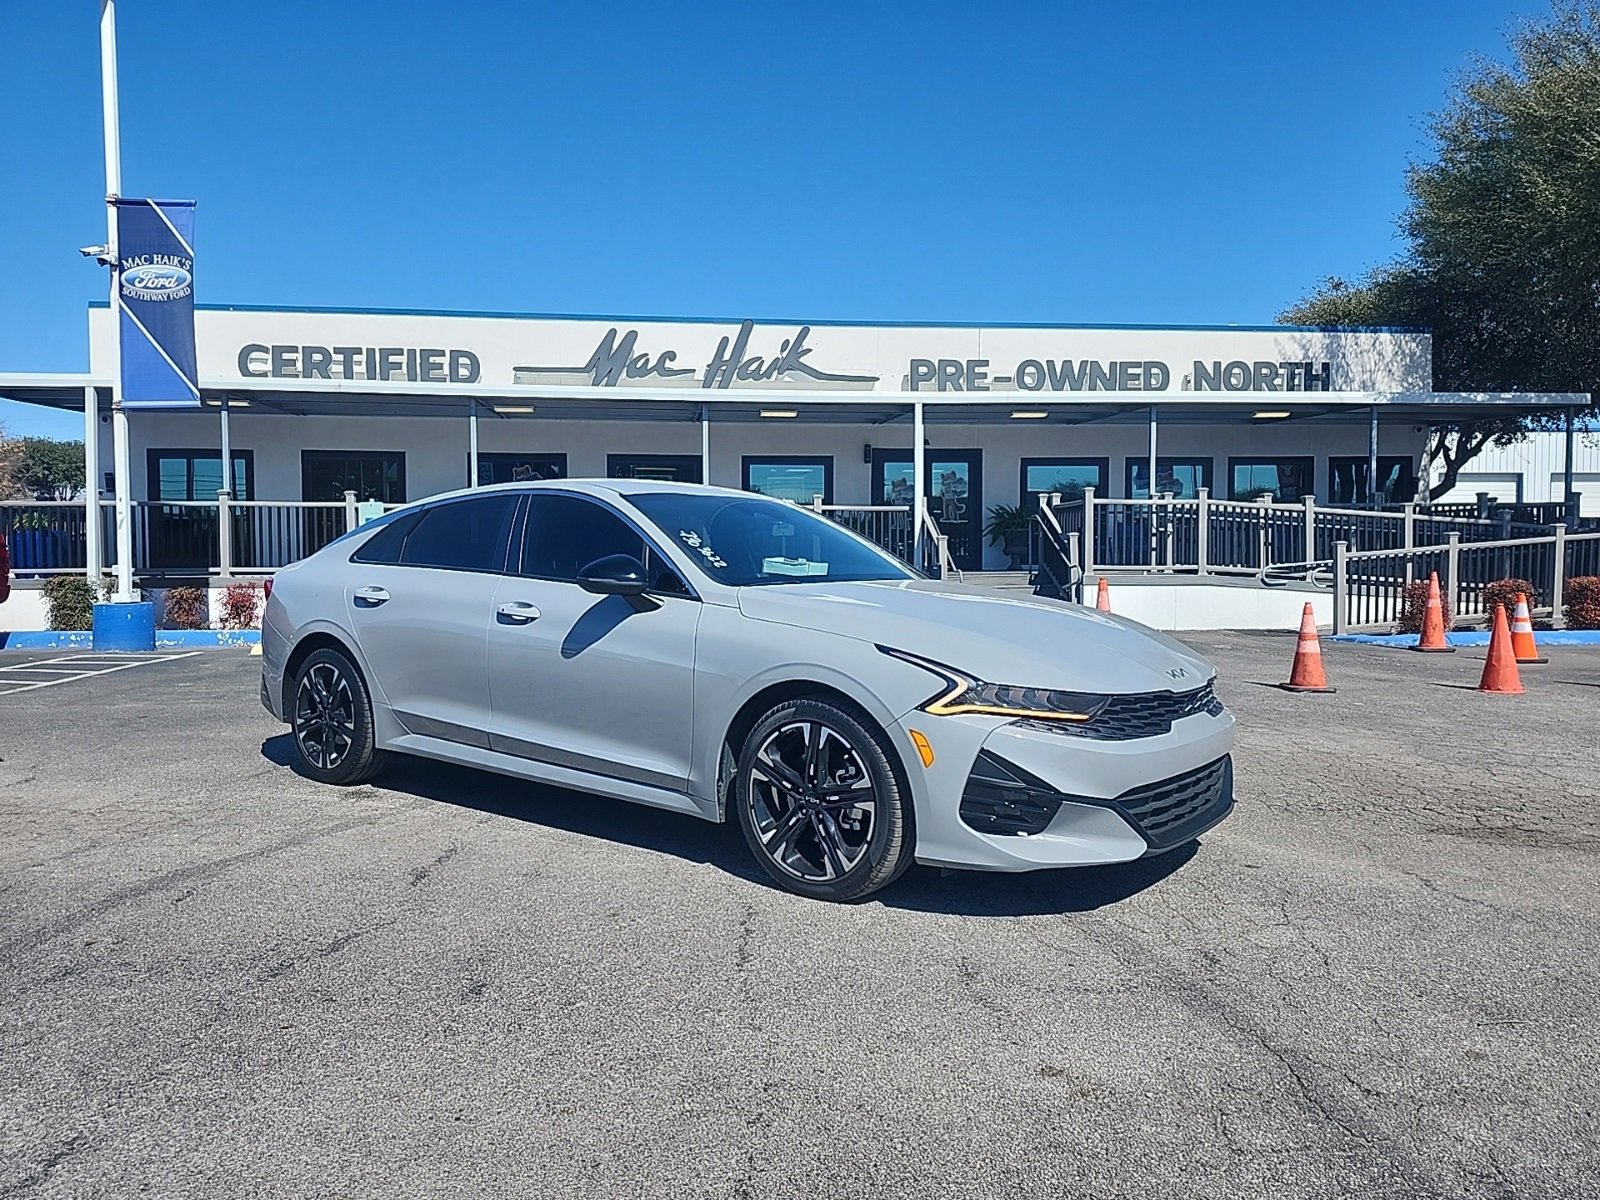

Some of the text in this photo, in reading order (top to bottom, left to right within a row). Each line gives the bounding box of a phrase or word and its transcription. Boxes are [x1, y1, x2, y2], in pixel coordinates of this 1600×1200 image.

[121, 253, 192, 270] MAC HAIK'S
[134, 269, 179, 288] Ford
[121, 286, 191, 302] SOUTHWAY FORD
[238, 343, 481, 384] CERTIFIED
[513, 318, 880, 389] Mac Haik
[909, 358, 1331, 392] PRE-OWNED NORTH
